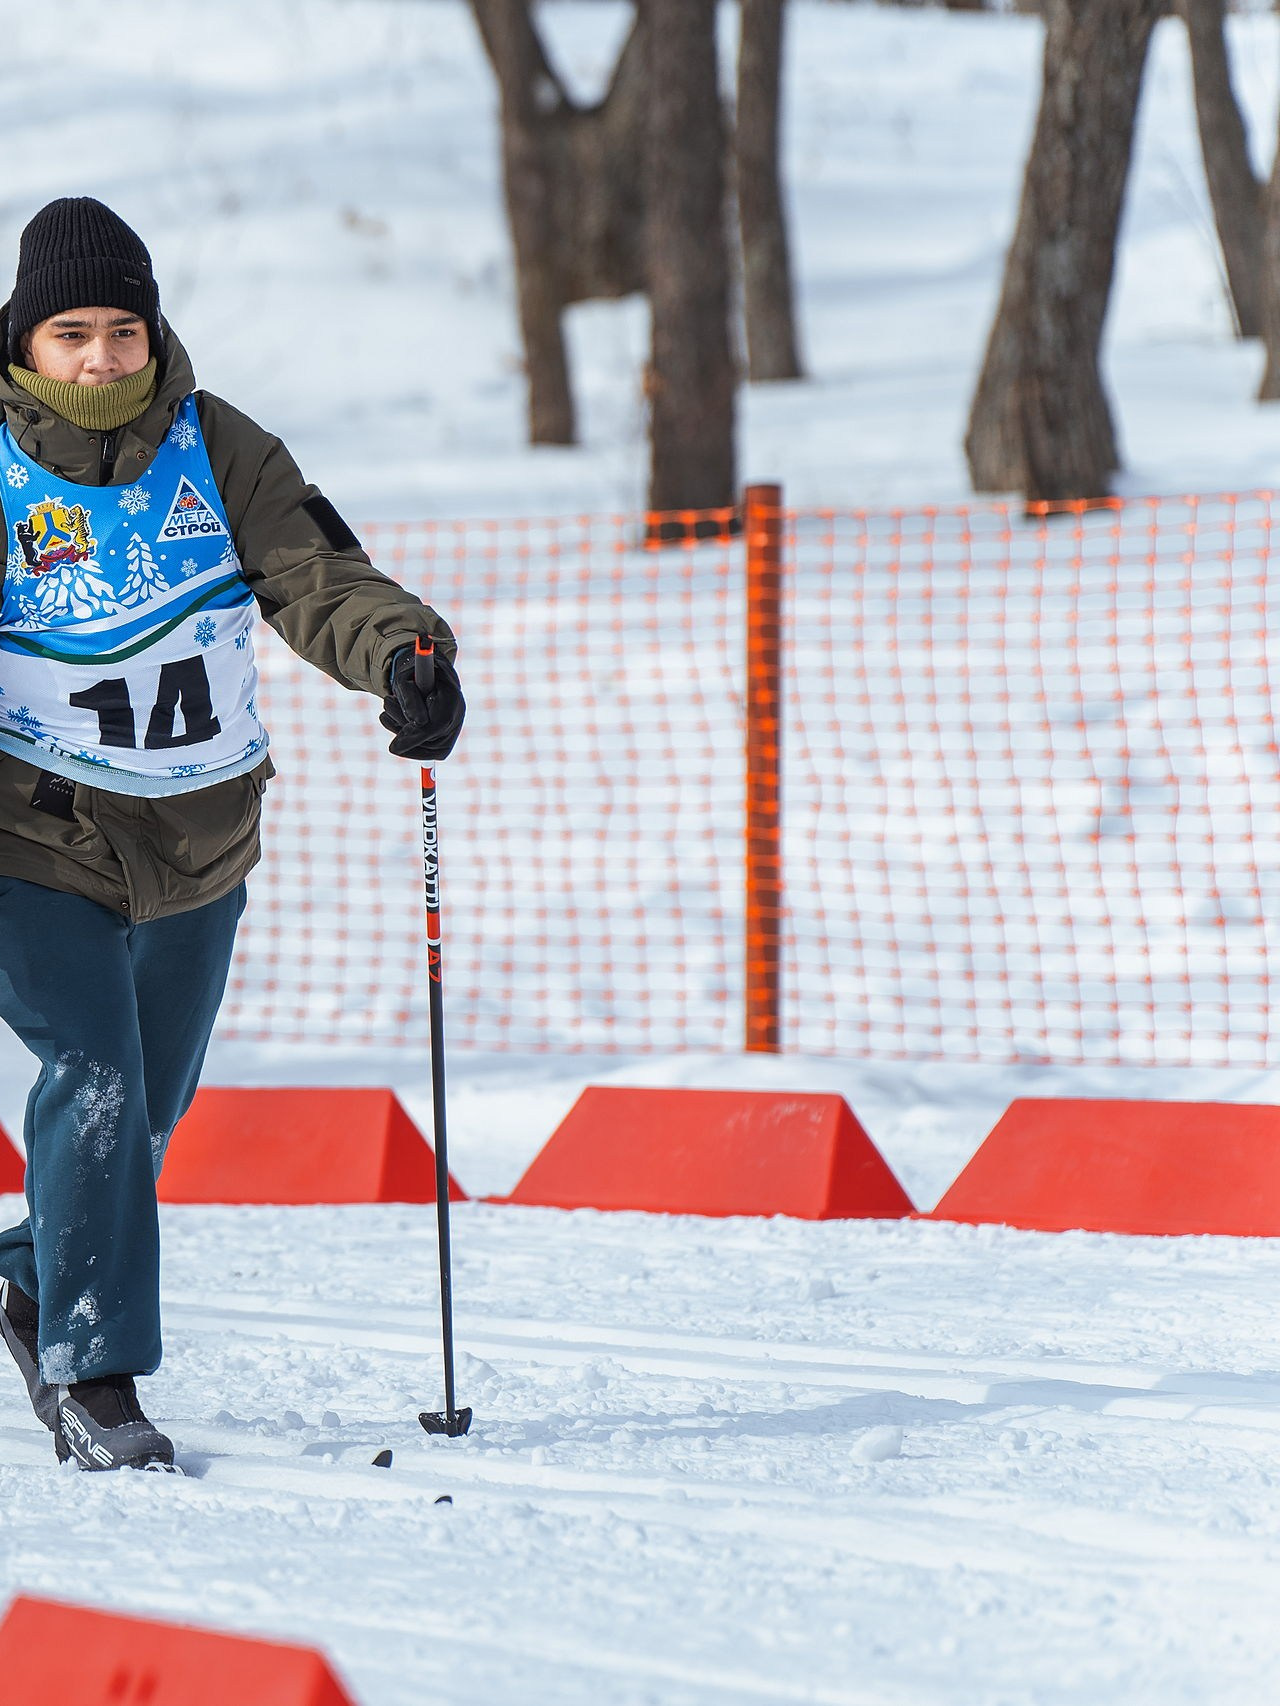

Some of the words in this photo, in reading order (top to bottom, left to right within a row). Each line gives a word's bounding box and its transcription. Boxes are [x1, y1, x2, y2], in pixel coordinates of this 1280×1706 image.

[164, 522, 221, 537] СТРОЙ
[168, 511, 216, 526] МЕГА
[69, 654, 222, 750] 14
[422, 793, 439, 908] VUOKATTI
[62, 1407, 114, 1467] SPINE
